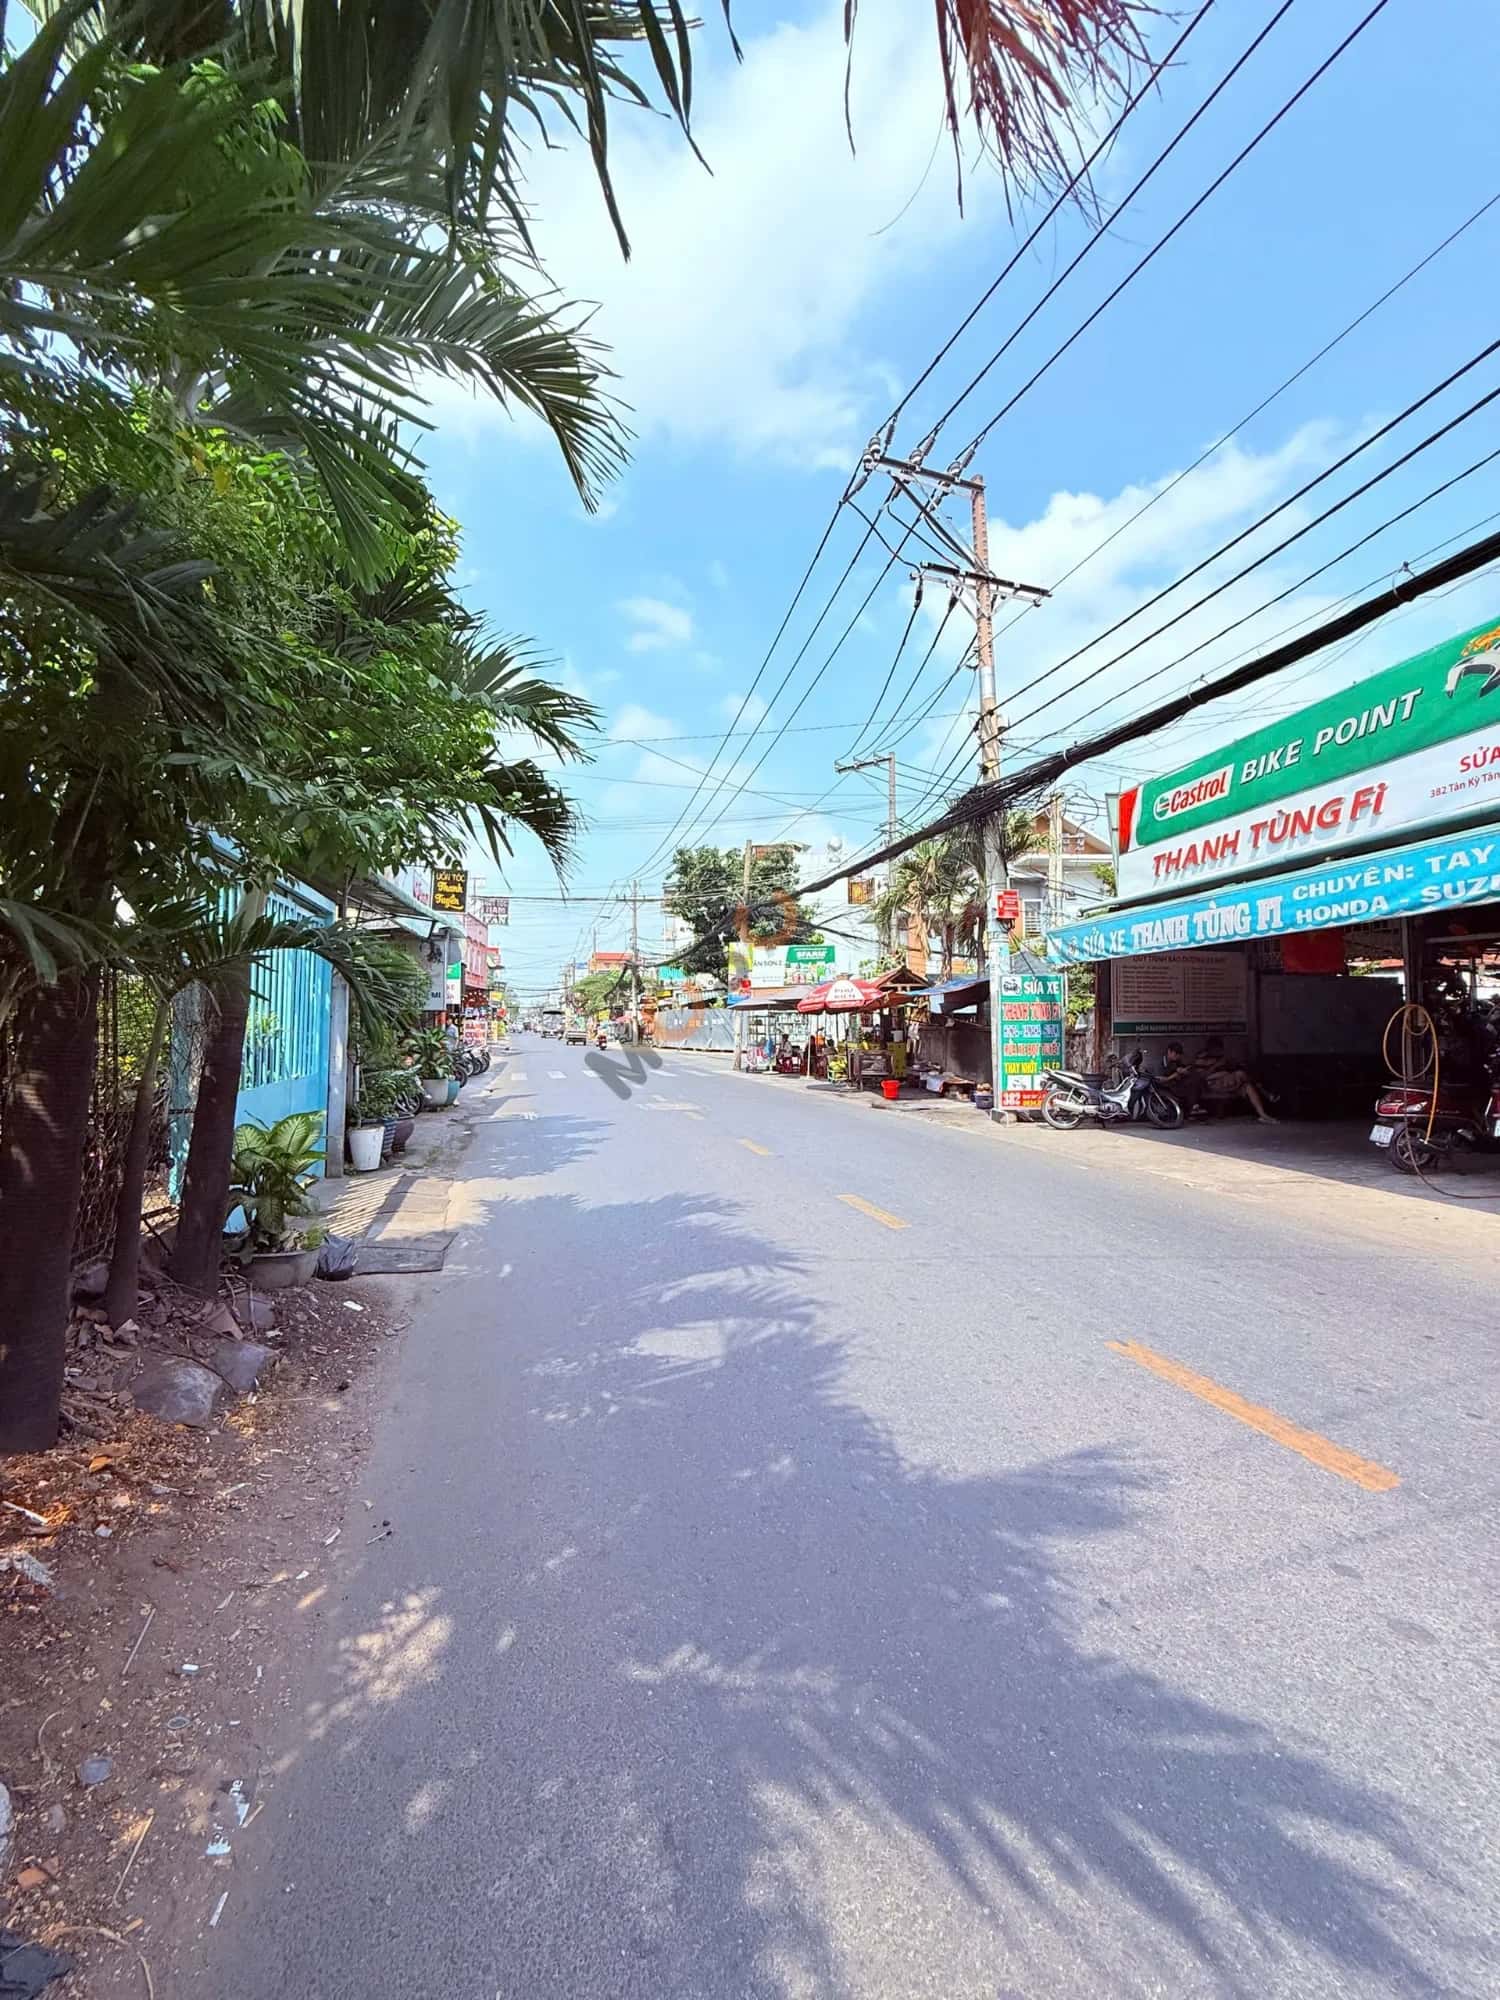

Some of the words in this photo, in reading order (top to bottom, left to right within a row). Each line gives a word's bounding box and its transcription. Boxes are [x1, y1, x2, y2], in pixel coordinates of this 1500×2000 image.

[1239, 739, 1304, 785] BIKE
[1312, 688, 1424, 756] POINT
[1170, 770, 1228, 813] Castrol
[1429, 786, 1447, 799] 382
[1449, 781, 1466, 792] Tân
[1153, 830, 1241, 877] THANH
[1250, 797, 1345, 849] TÙNG
[1292, 864, 1415, 901] CHUYÊN:
[1425, 843, 1496, 874] TAY
[1083, 927, 1105, 955] SỬA
[1110, 929, 1126, 953] XE
[1130, 915, 1189, 950] THANH
[1193, 900, 1251, 941] TÙNG
[1295, 895, 1390, 924] HONDA
[1023, 976, 1044, 995] SỬA
[1047, 981, 1060, 995] XE
